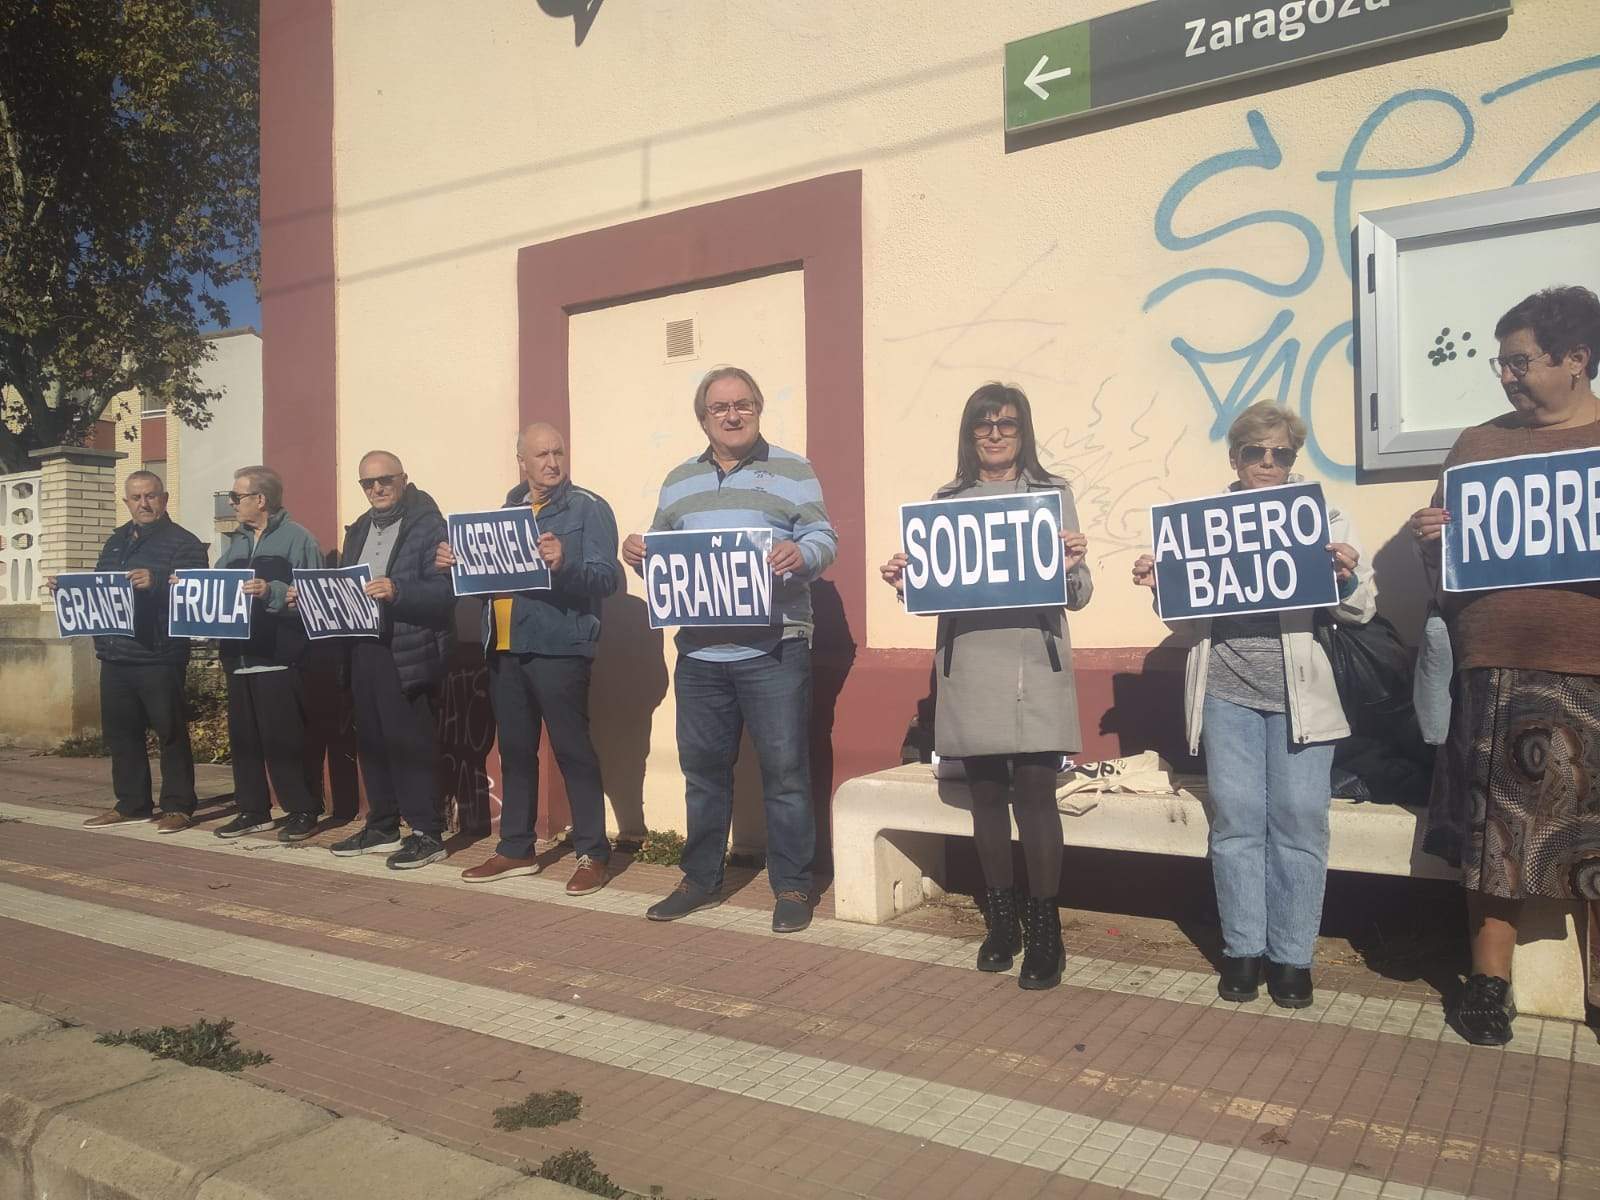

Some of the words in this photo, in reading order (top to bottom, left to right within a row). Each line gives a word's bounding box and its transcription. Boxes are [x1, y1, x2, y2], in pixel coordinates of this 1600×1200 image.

[452, 519, 548, 577] ALBERUELA
[906, 508, 1059, 589] SODETO
[1156, 496, 1322, 563] ALBERO
[57, 575, 134, 631] GRAÑÉN
[173, 578, 248, 624] FRULA
[648, 532, 770, 619] GRAÑÉN
[1186, 550, 1297, 608] BAJO
